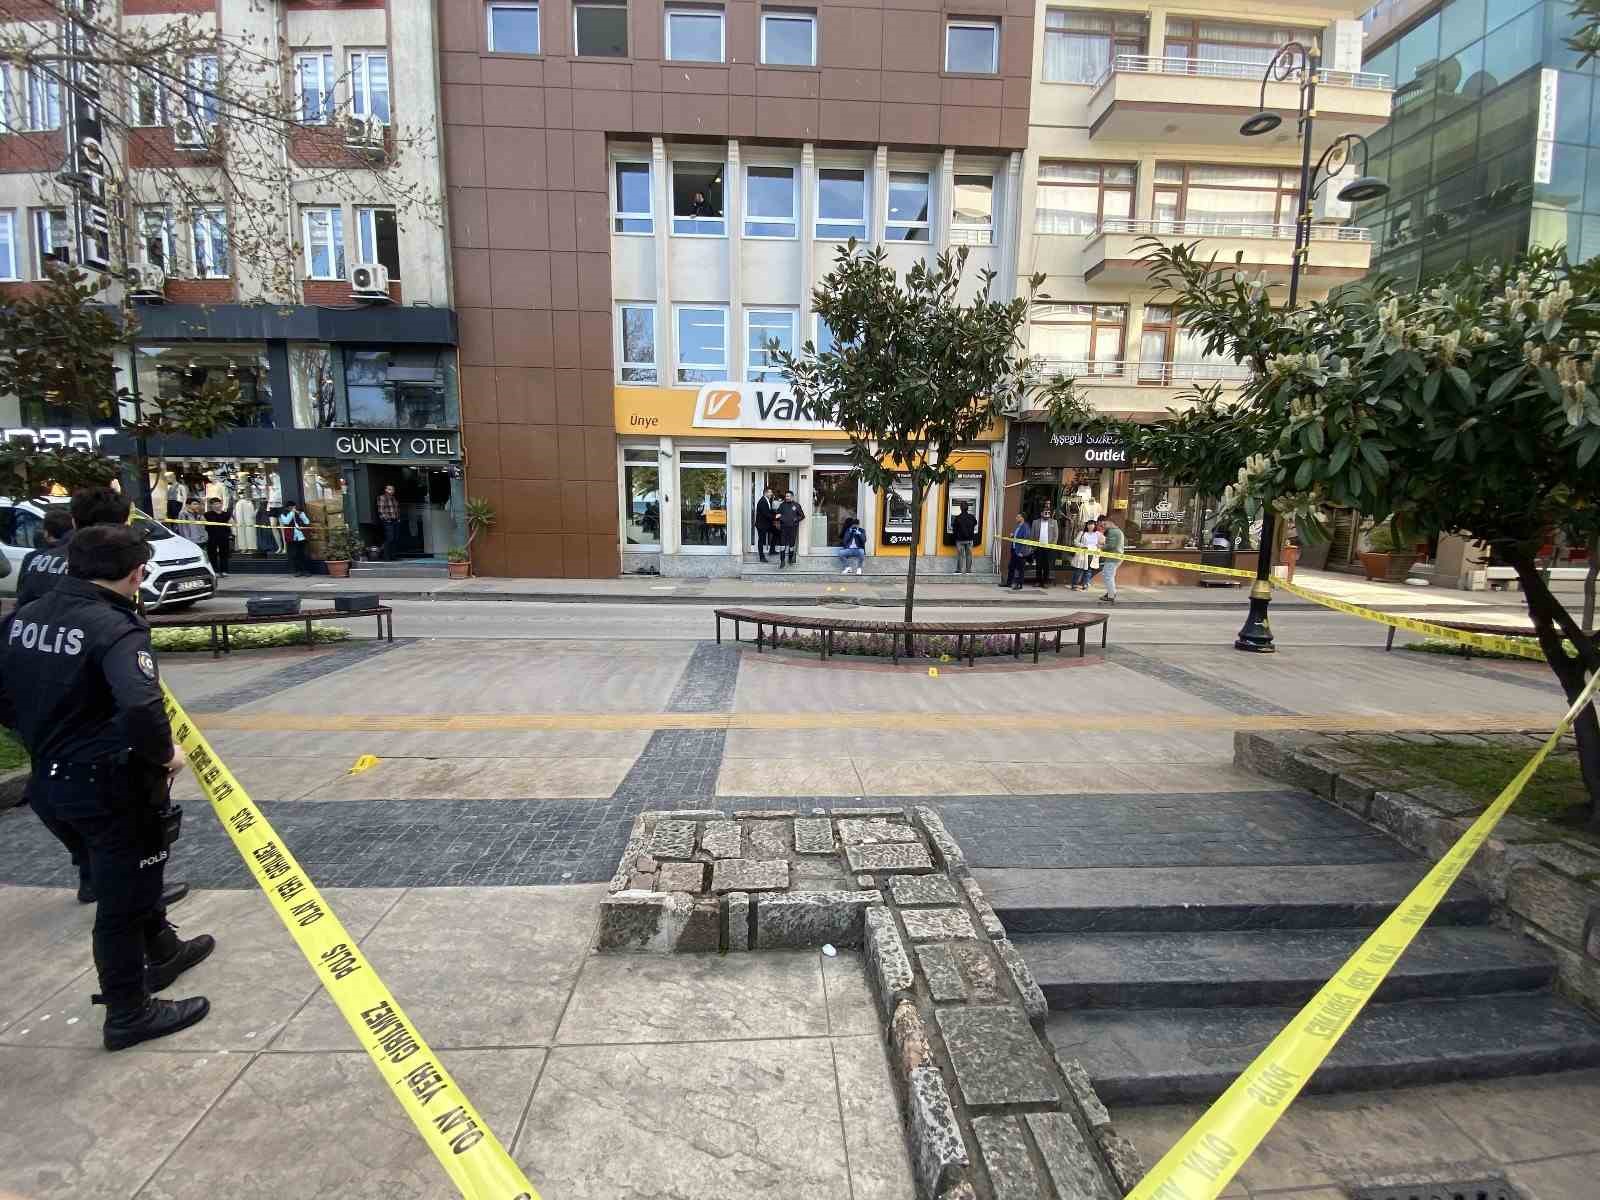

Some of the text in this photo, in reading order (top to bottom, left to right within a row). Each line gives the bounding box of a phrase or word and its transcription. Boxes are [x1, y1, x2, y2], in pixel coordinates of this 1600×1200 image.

[336, 433, 456, 455] GÜNEY OTEL
[1050, 432, 1083, 446] Ayşegül
[1085, 448, 1126, 462] Outlet
[290, 899, 325, 927] OLAY
[433, 1106, 484, 1155] OLAY
